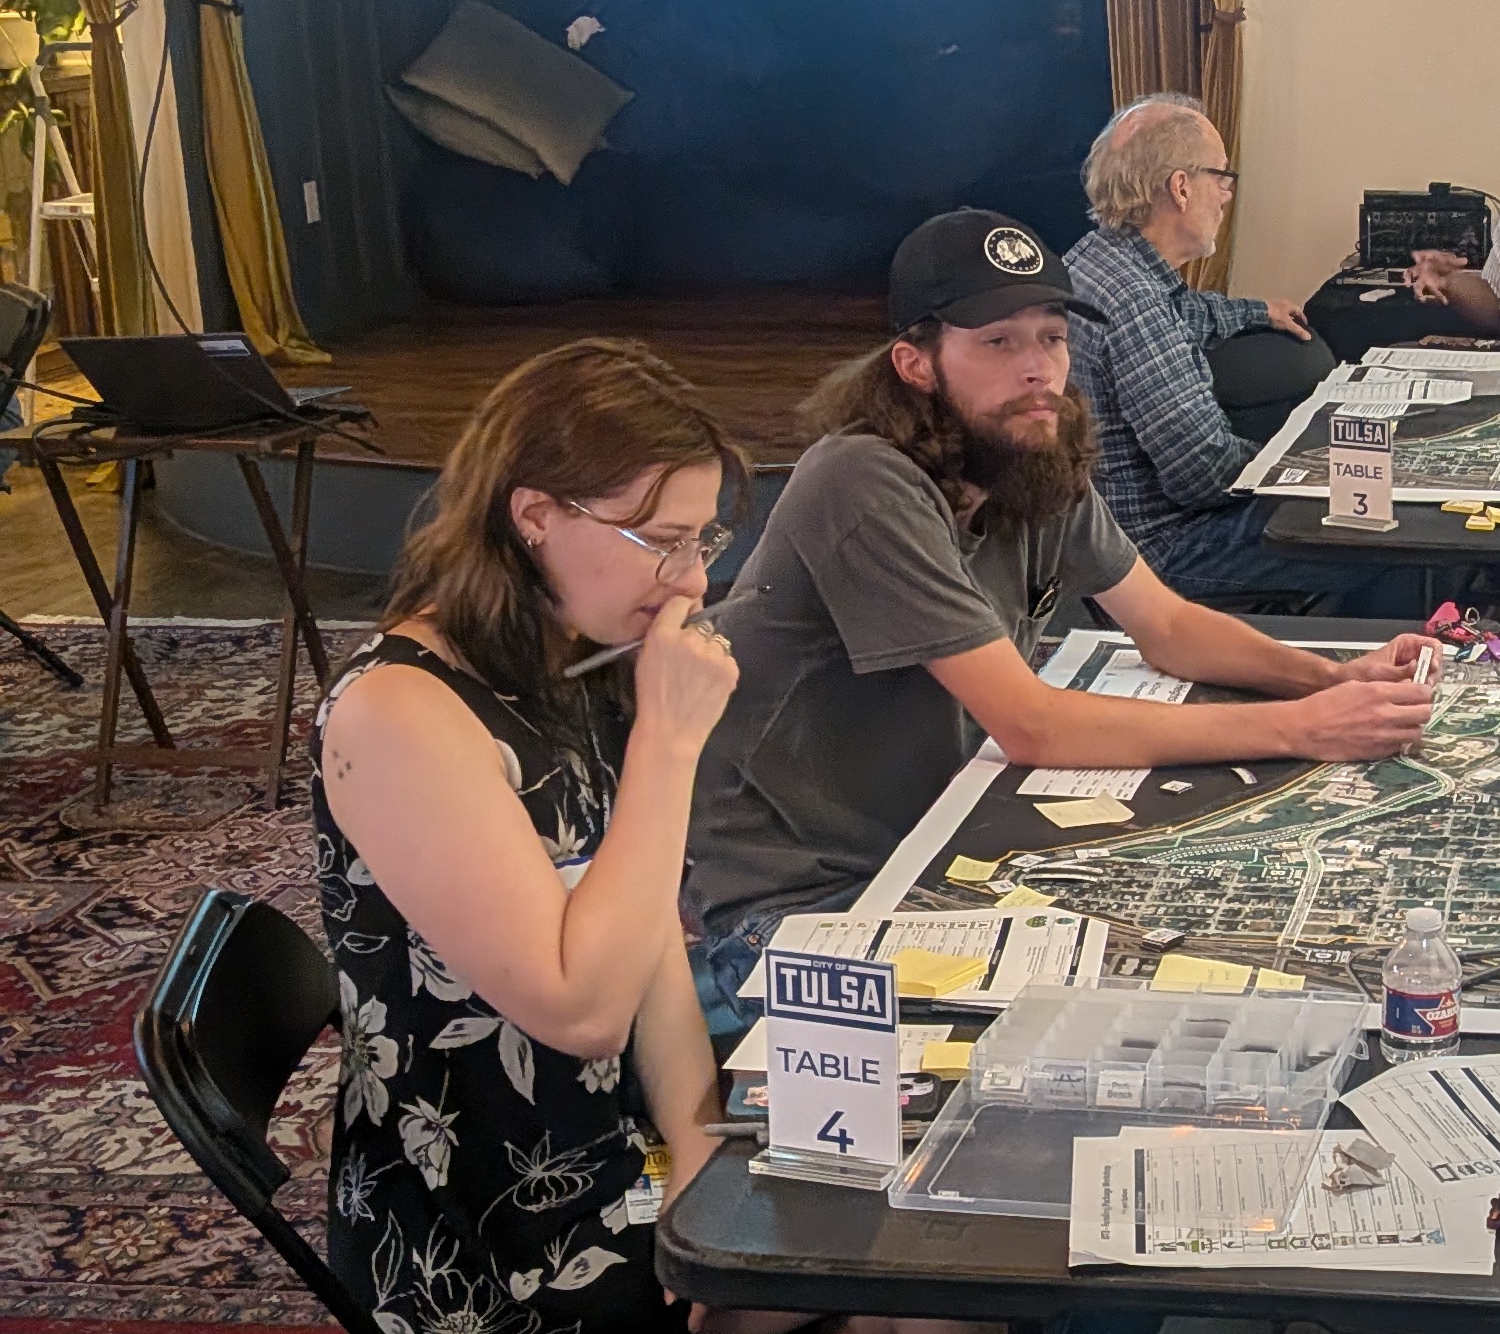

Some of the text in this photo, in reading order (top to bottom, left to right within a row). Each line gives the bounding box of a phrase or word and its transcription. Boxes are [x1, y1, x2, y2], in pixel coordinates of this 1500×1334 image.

[1335, 422, 1384, 443] TULSA
[1333, 462, 1384, 480] TABLE
[1352, 492, 1368, 516] 3
[812, 960, 848, 971] CITY OF
[780, 967, 882, 1014] TULSA
[776, 1047, 881, 1085] TABLE
[816, 1110, 854, 1154] 4
